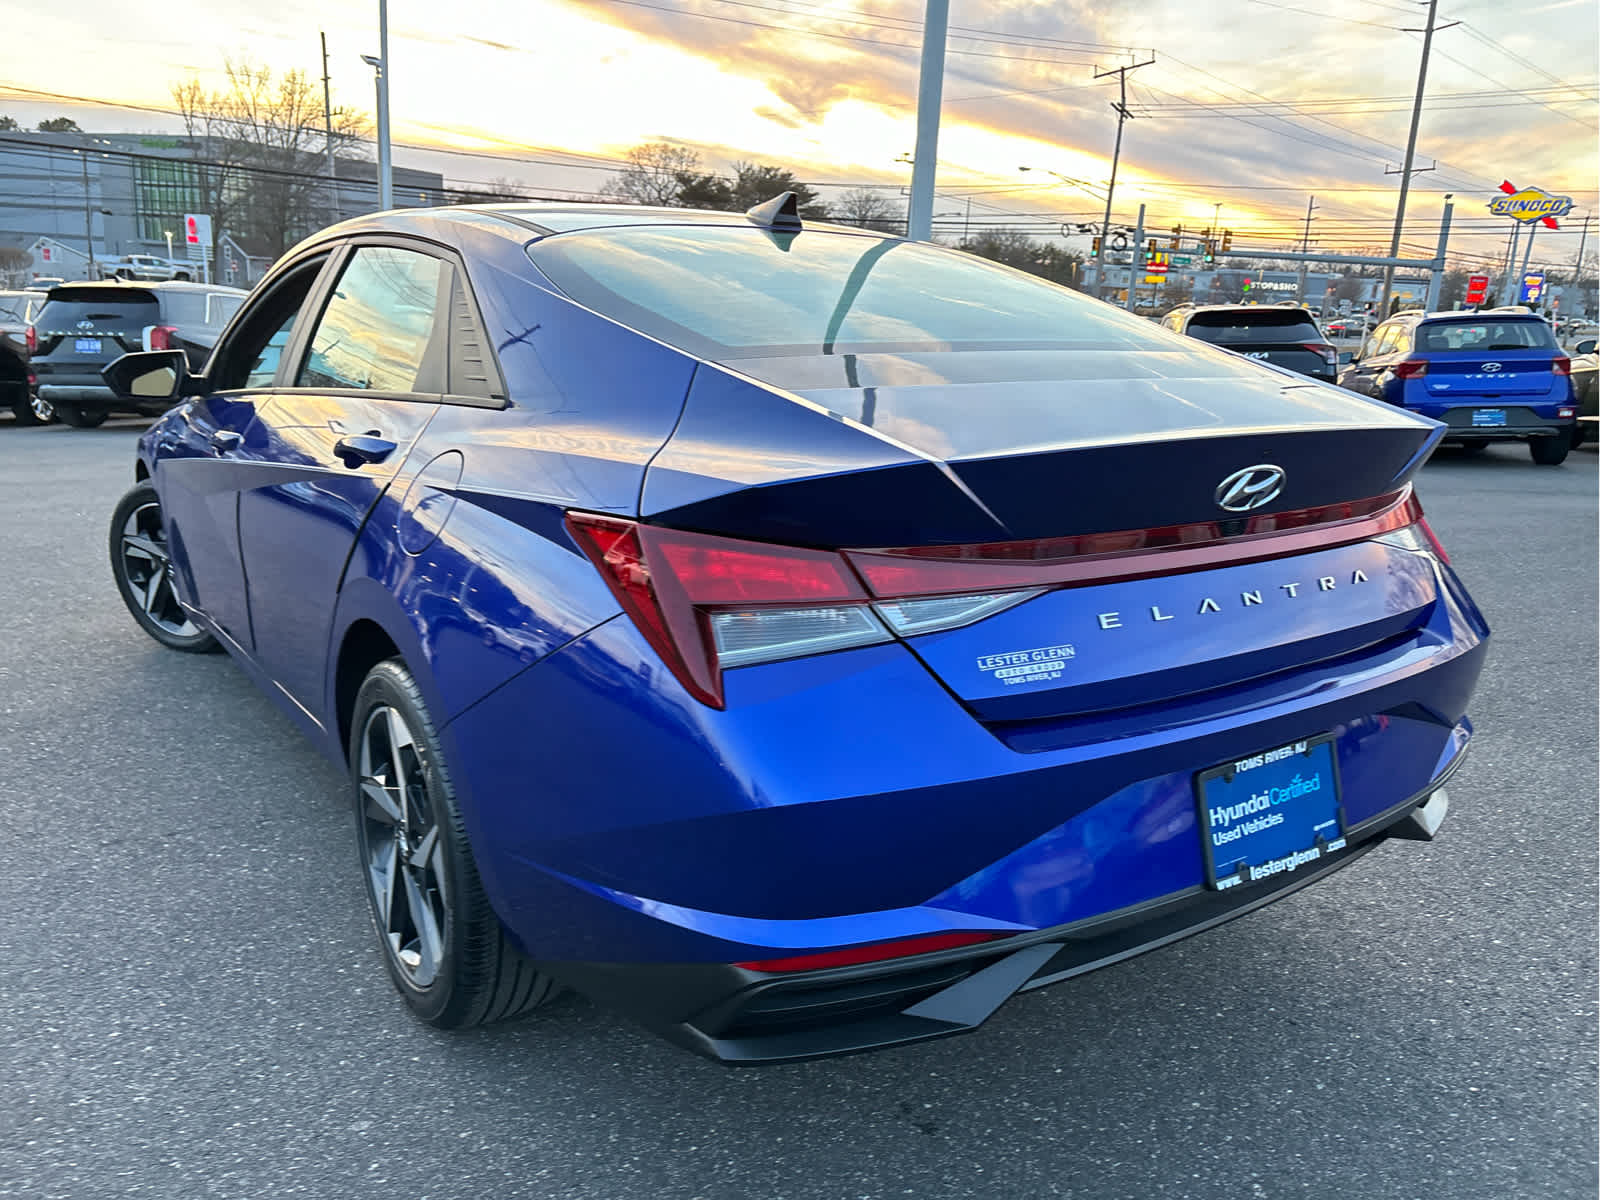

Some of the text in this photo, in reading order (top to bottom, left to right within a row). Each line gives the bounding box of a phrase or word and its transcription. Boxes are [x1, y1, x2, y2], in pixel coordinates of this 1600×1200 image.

[1494, 199, 1564, 212] SUNOCO
[1097, 569, 1369, 630] ELANTRA
[977, 646, 1075, 669] LESTER GLENN
[1003, 676, 1026, 686] TOMS
[1234, 755, 1264, 773] TOMS
[1295, 741, 1308, 754] NJ
[1212, 812, 1285, 847] Used Vehicles
[1249, 847, 1321, 881] lesterglenn
